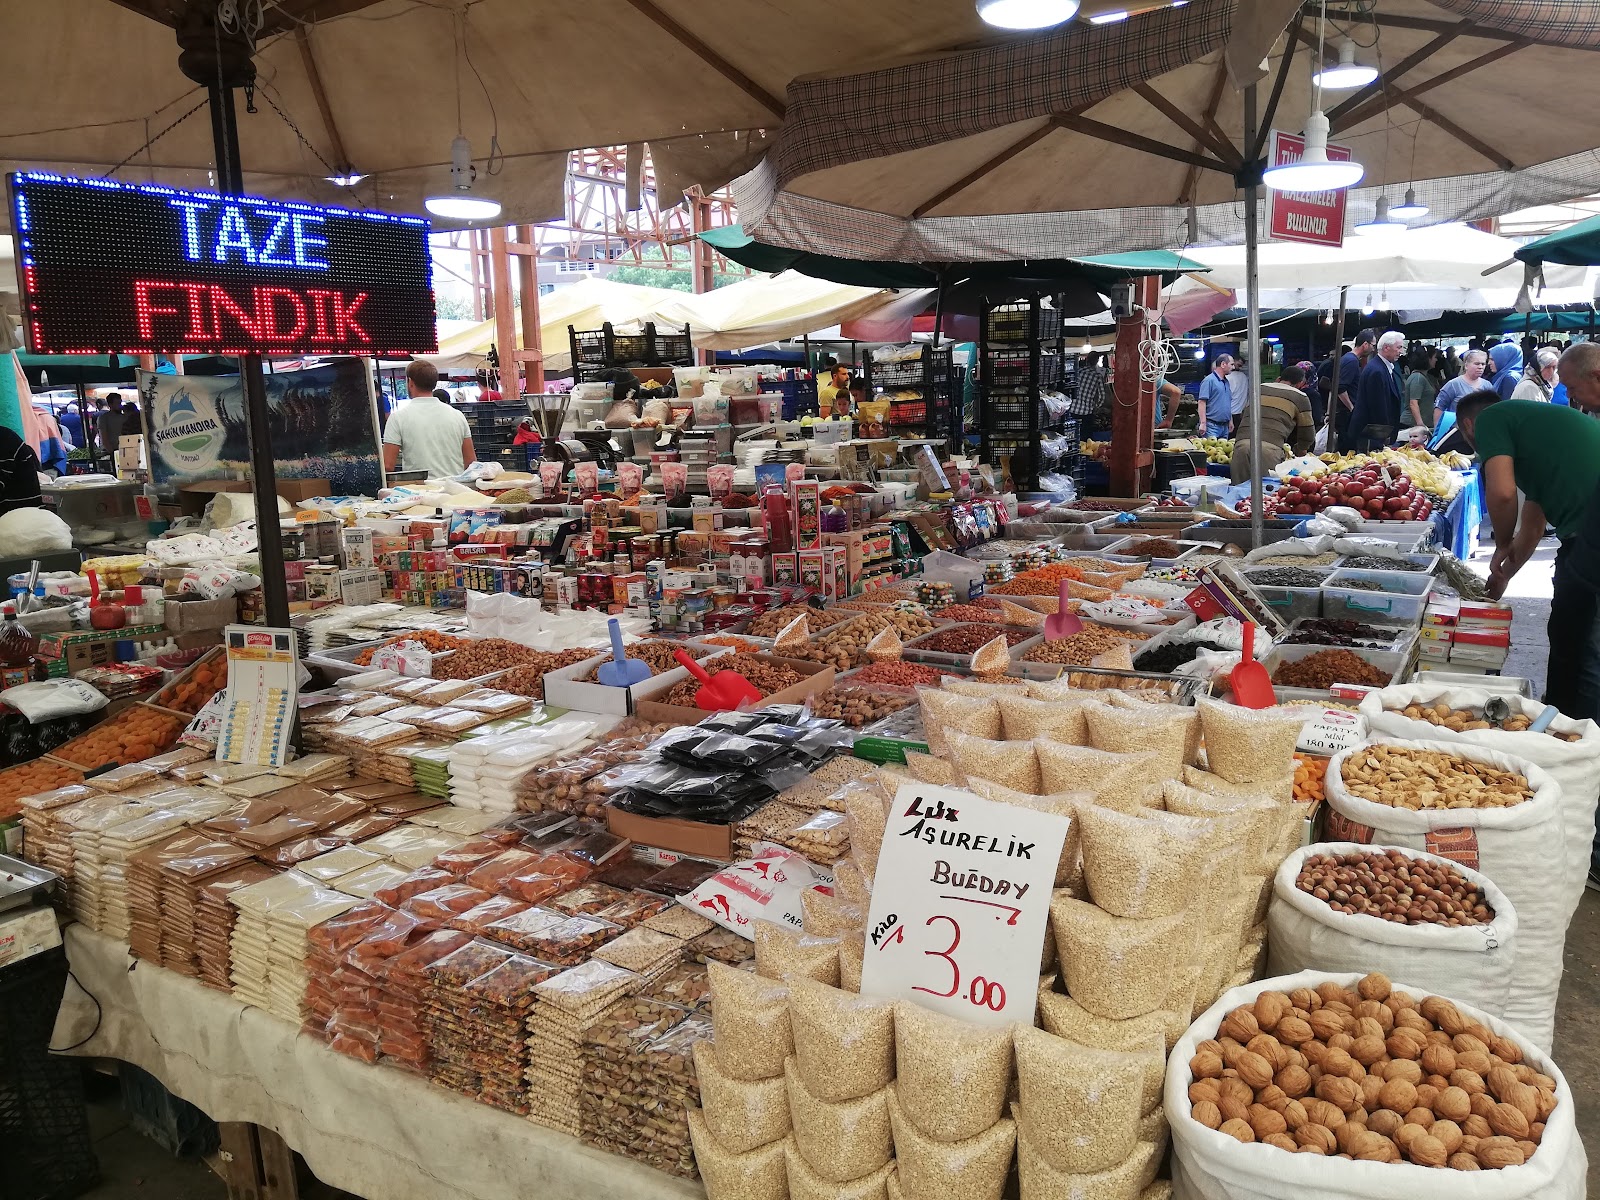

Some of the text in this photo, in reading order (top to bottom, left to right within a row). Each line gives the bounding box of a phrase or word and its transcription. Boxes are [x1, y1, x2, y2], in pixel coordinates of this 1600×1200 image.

[168, 199, 331, 269] TAZE
[1287, 213, 1327, 235] BULUNUR
[135, 279, 372, 343] FINDIK
[1313, 724, 1359, 735] PAPATYA
[899, 818, 1036, 859] AŞURELİK
[911, 914, 1007, 1012] 3.00
